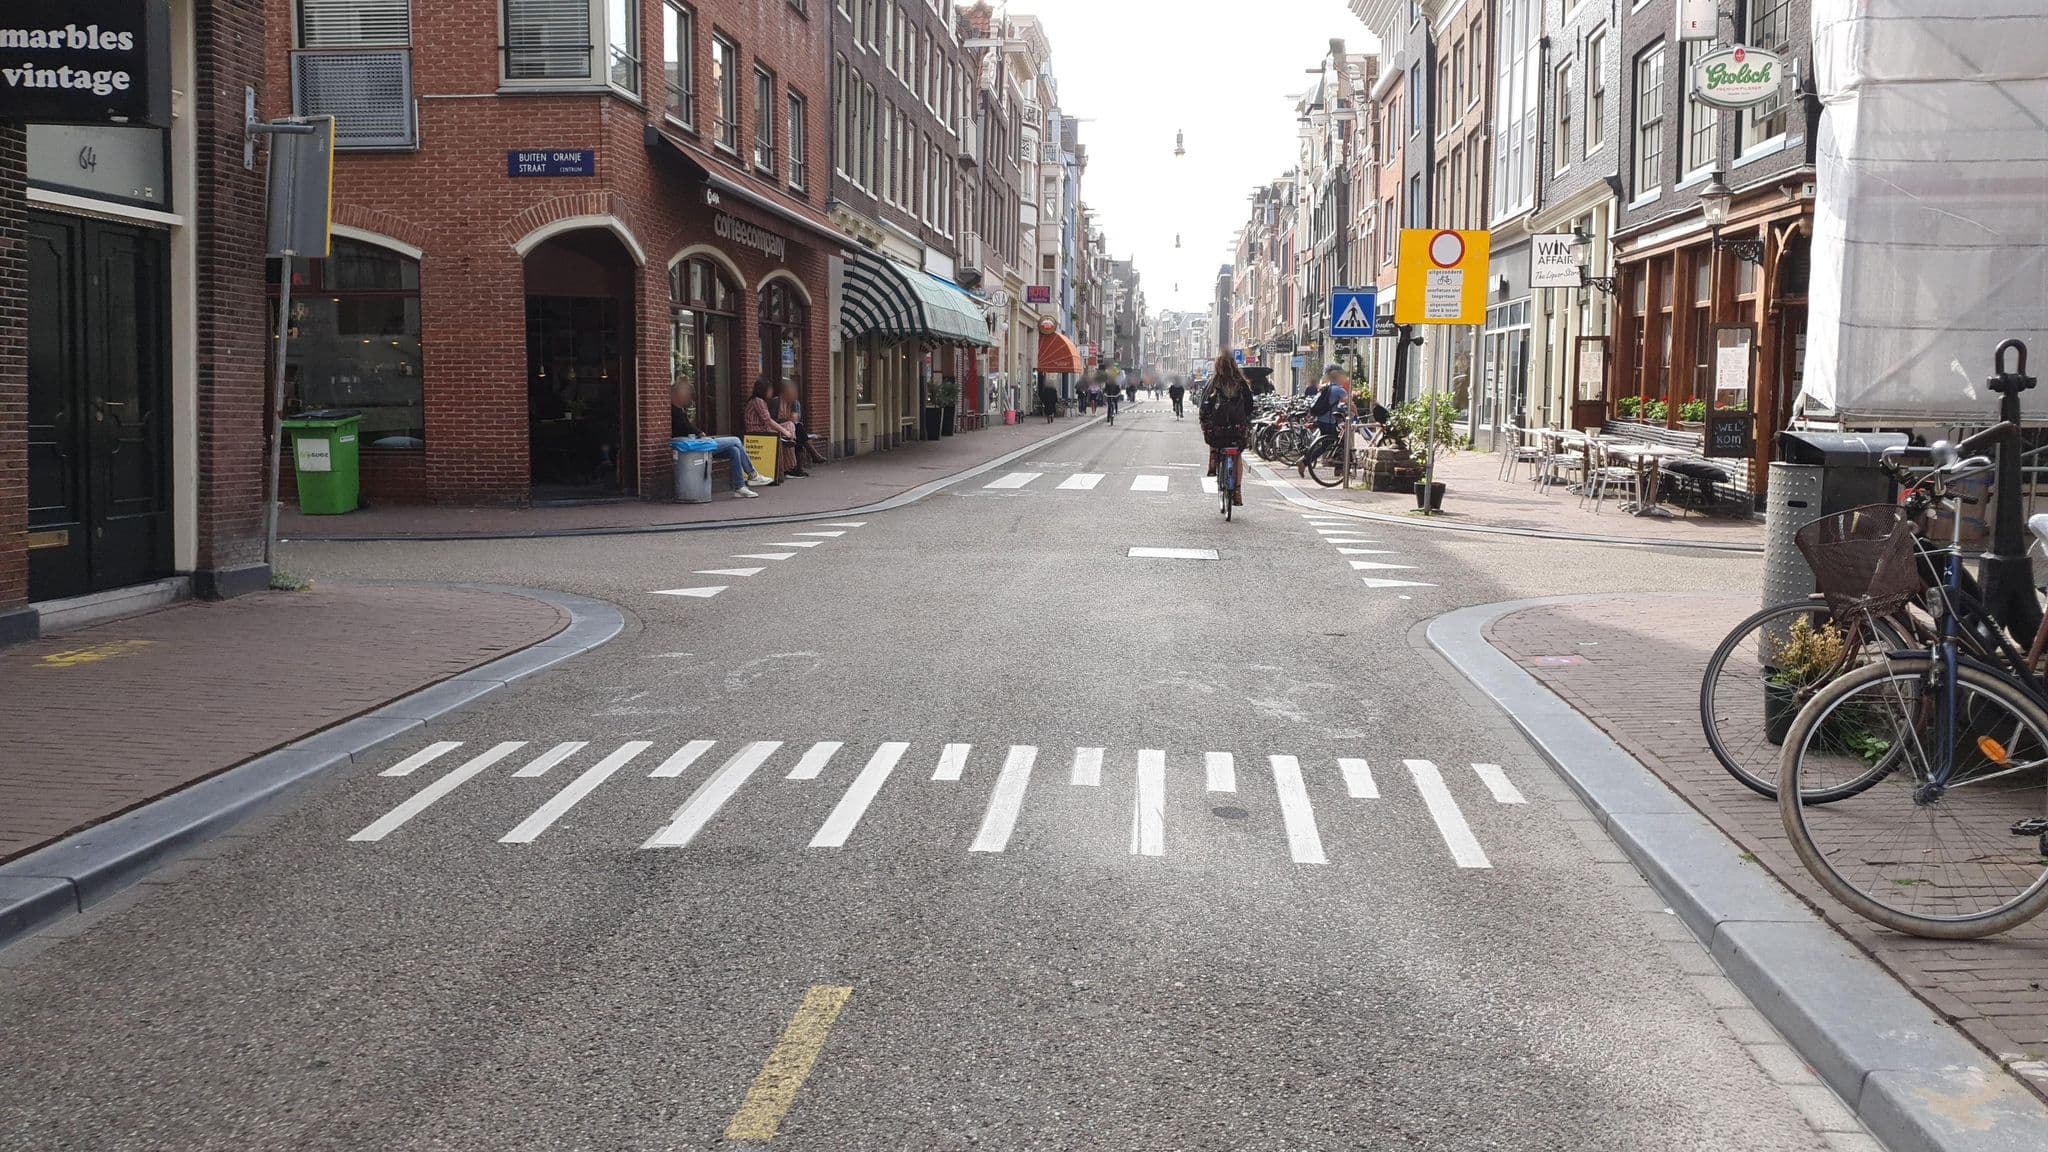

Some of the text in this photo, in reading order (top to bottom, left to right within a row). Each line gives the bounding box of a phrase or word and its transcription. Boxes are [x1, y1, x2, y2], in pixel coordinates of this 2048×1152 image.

[0, 24, 134, 51] marbles
[2, 62, 131, 96] vintage
[1705, 61, 1773, 90] Grolsch
[79, 145, 98, 174] 64
[519, 152, 582, 163] BUITEN ORANJE
[519, 163, 546, 173] STRAAT
[714, 213, 786, 263] coffeecompany
